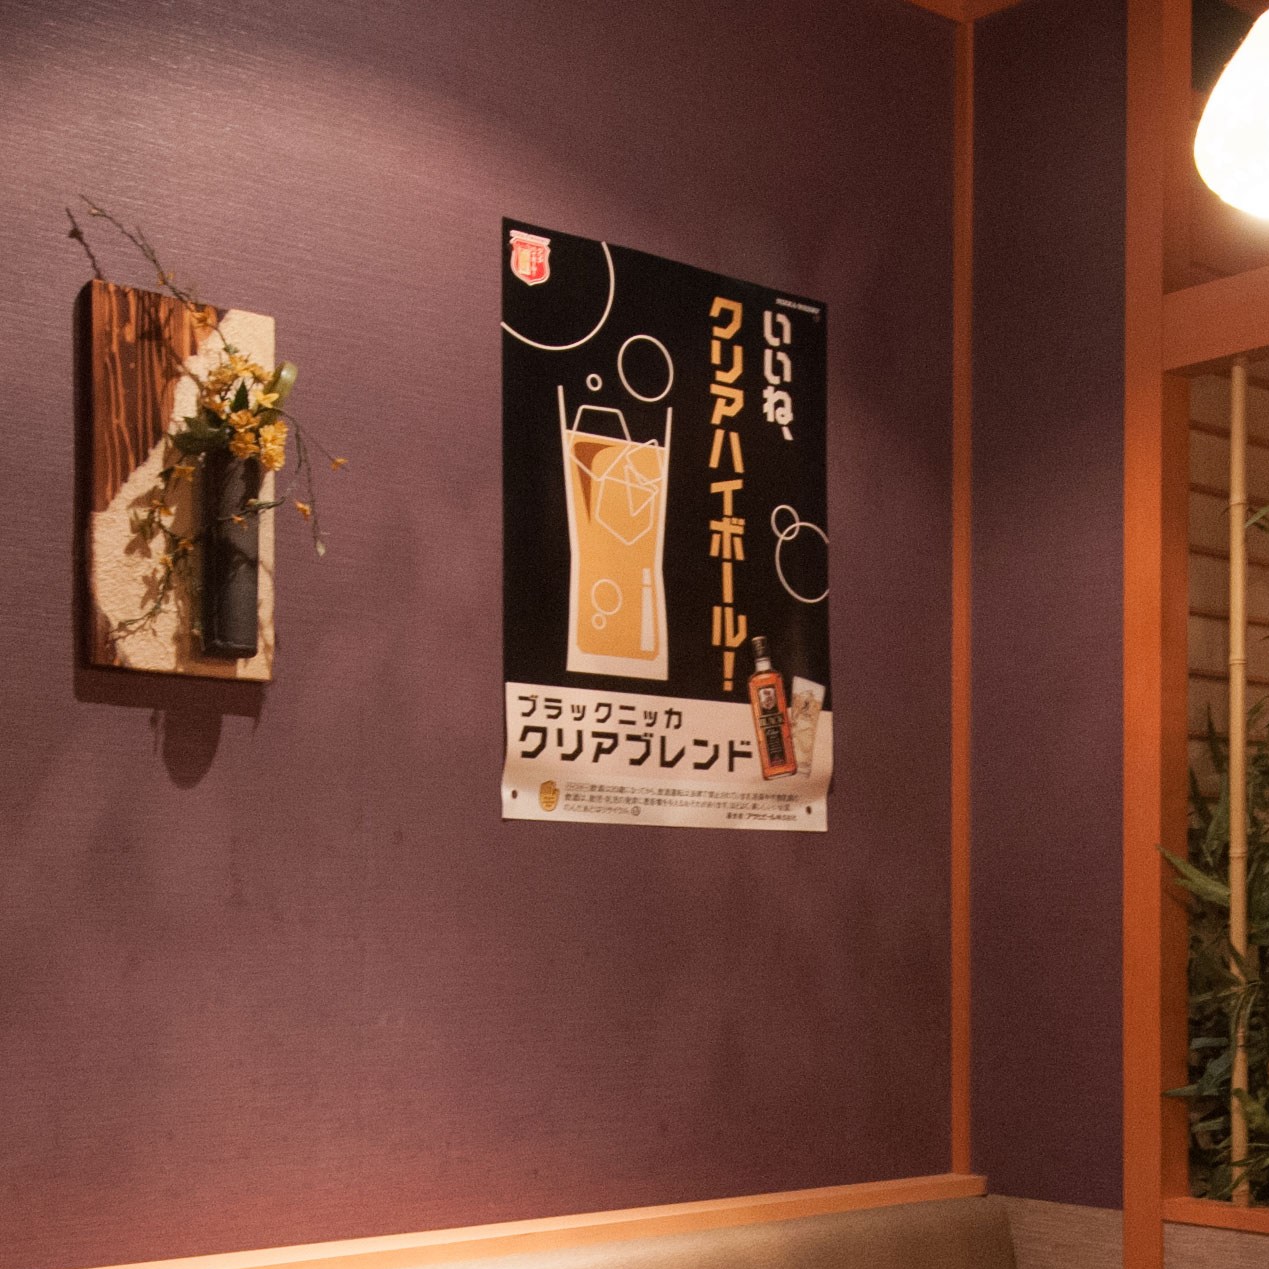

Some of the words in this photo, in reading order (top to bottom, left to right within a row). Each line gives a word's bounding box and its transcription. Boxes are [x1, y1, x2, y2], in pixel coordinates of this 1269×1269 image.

[763, 310, 794, 441] いいね、
[518, 694, 683, 731] ブラックニッカ
[518, 725, 754, 773] クリアブレンド
